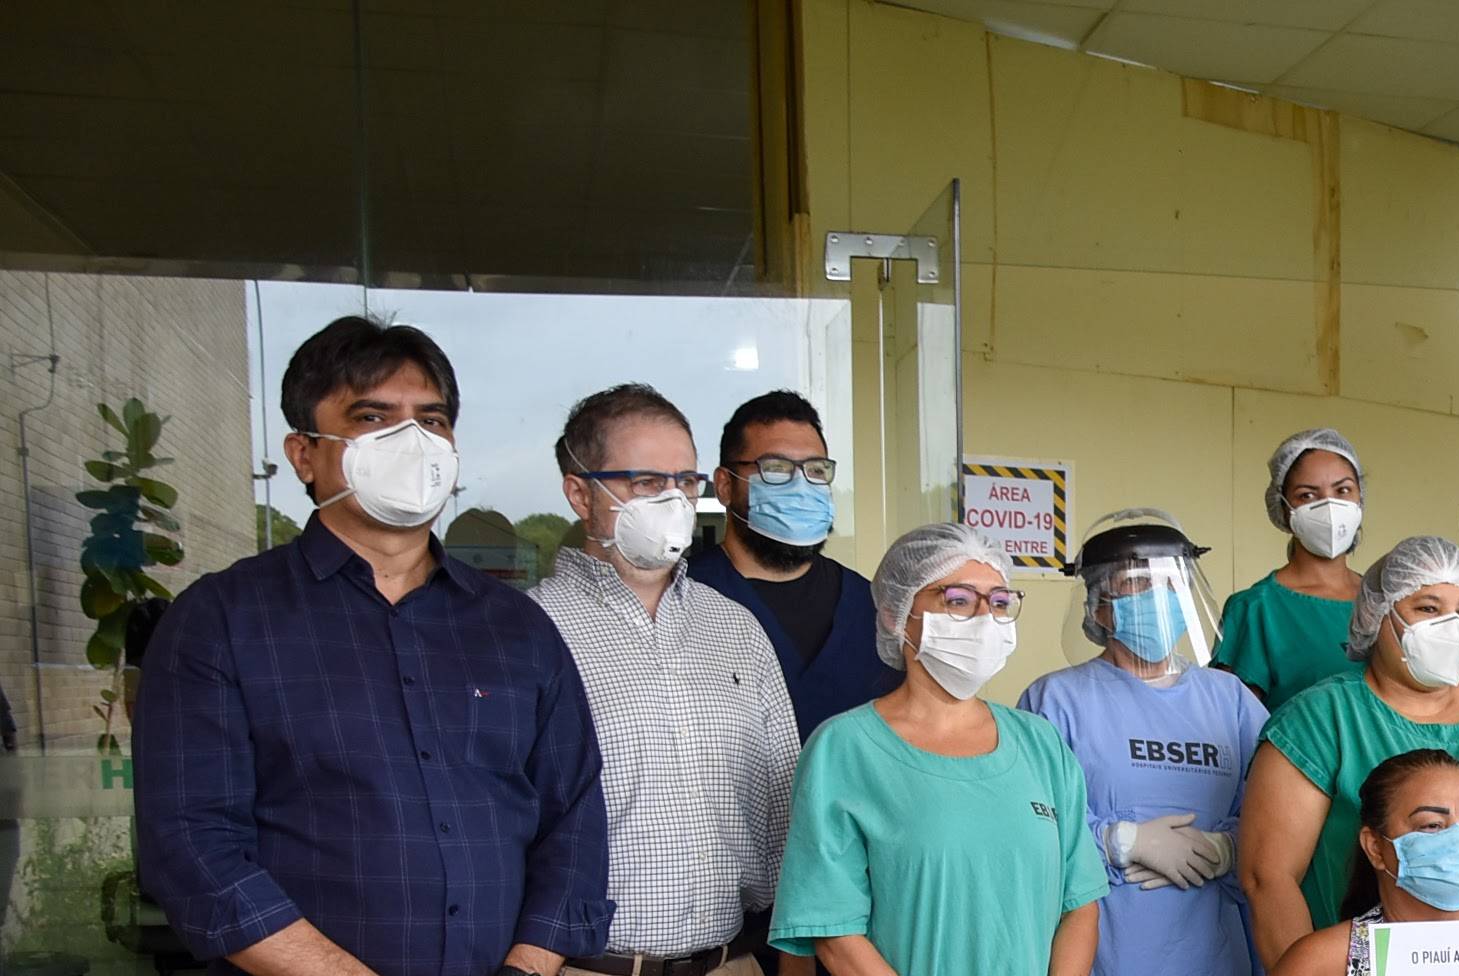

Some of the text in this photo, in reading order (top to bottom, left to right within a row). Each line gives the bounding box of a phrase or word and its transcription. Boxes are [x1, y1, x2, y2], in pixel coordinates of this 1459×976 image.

[988, 482, 1031, 503] ÁREA
[966, 508, 1054, 531] COVID-19
[1004, 539, 1048, 555] ENTRE
[1411, 951, 1419, 965] O
[1422, 946, 1451, 964] PIAUÍ
